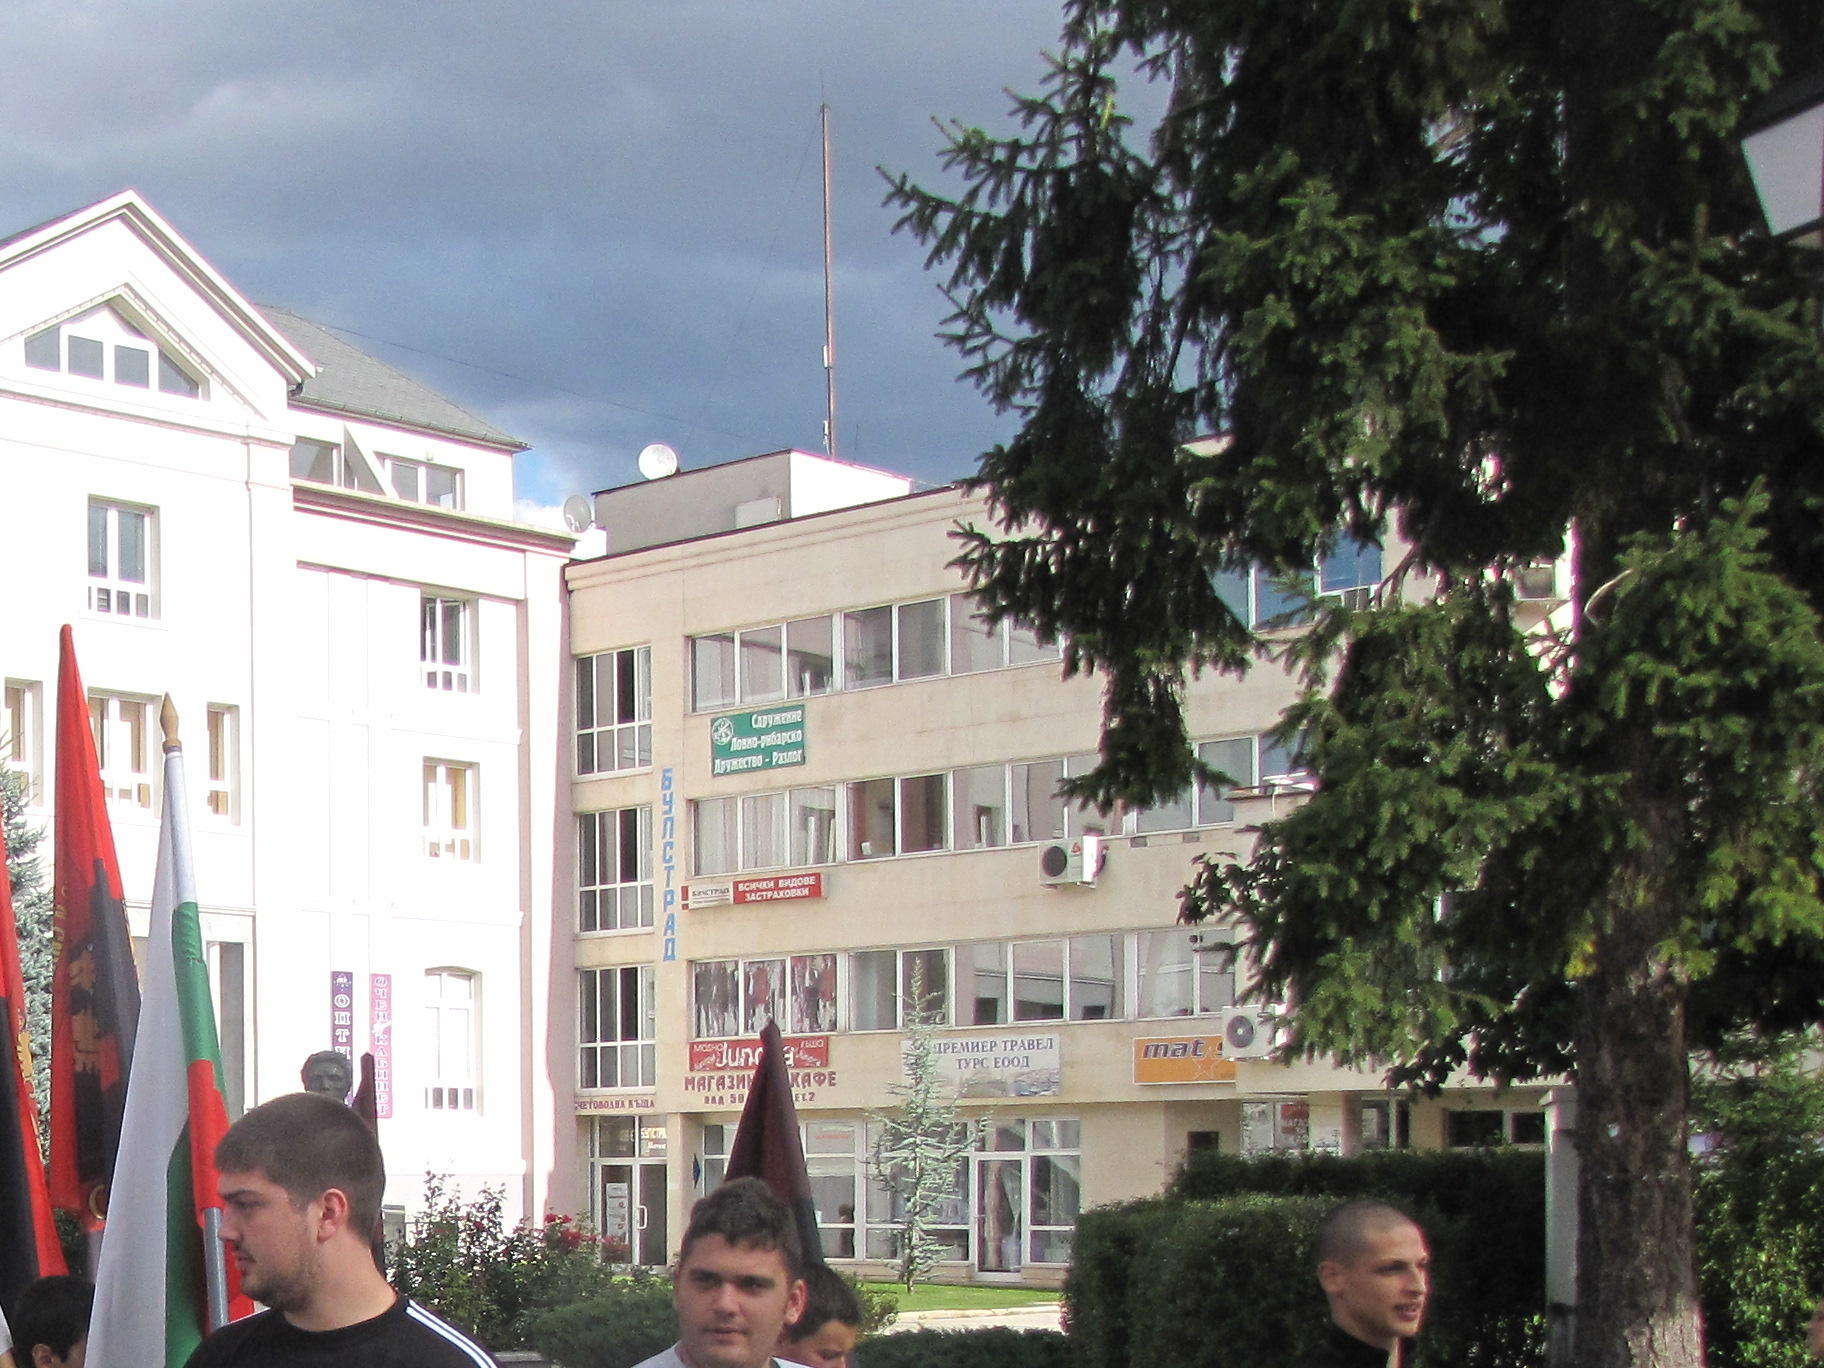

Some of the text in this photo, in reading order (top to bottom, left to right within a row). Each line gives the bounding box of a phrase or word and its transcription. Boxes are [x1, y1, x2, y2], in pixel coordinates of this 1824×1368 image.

[661, 768, 676, 962] БУЛСТРАД
[738, 876, 816, 892] ВСИЧКИ ВИДОВЕ
[745, 888, 809, 902] ЗАСТРАХОВКИ
[334, 993, 351, 1060] ОПТИ
[1002, 1037, 1054, 1051] ТРАВЕЛ
[956, 1055, 1031, 1070] ТУРС ЕООД
[790, 1071, 837, 1088] КАФЕ
